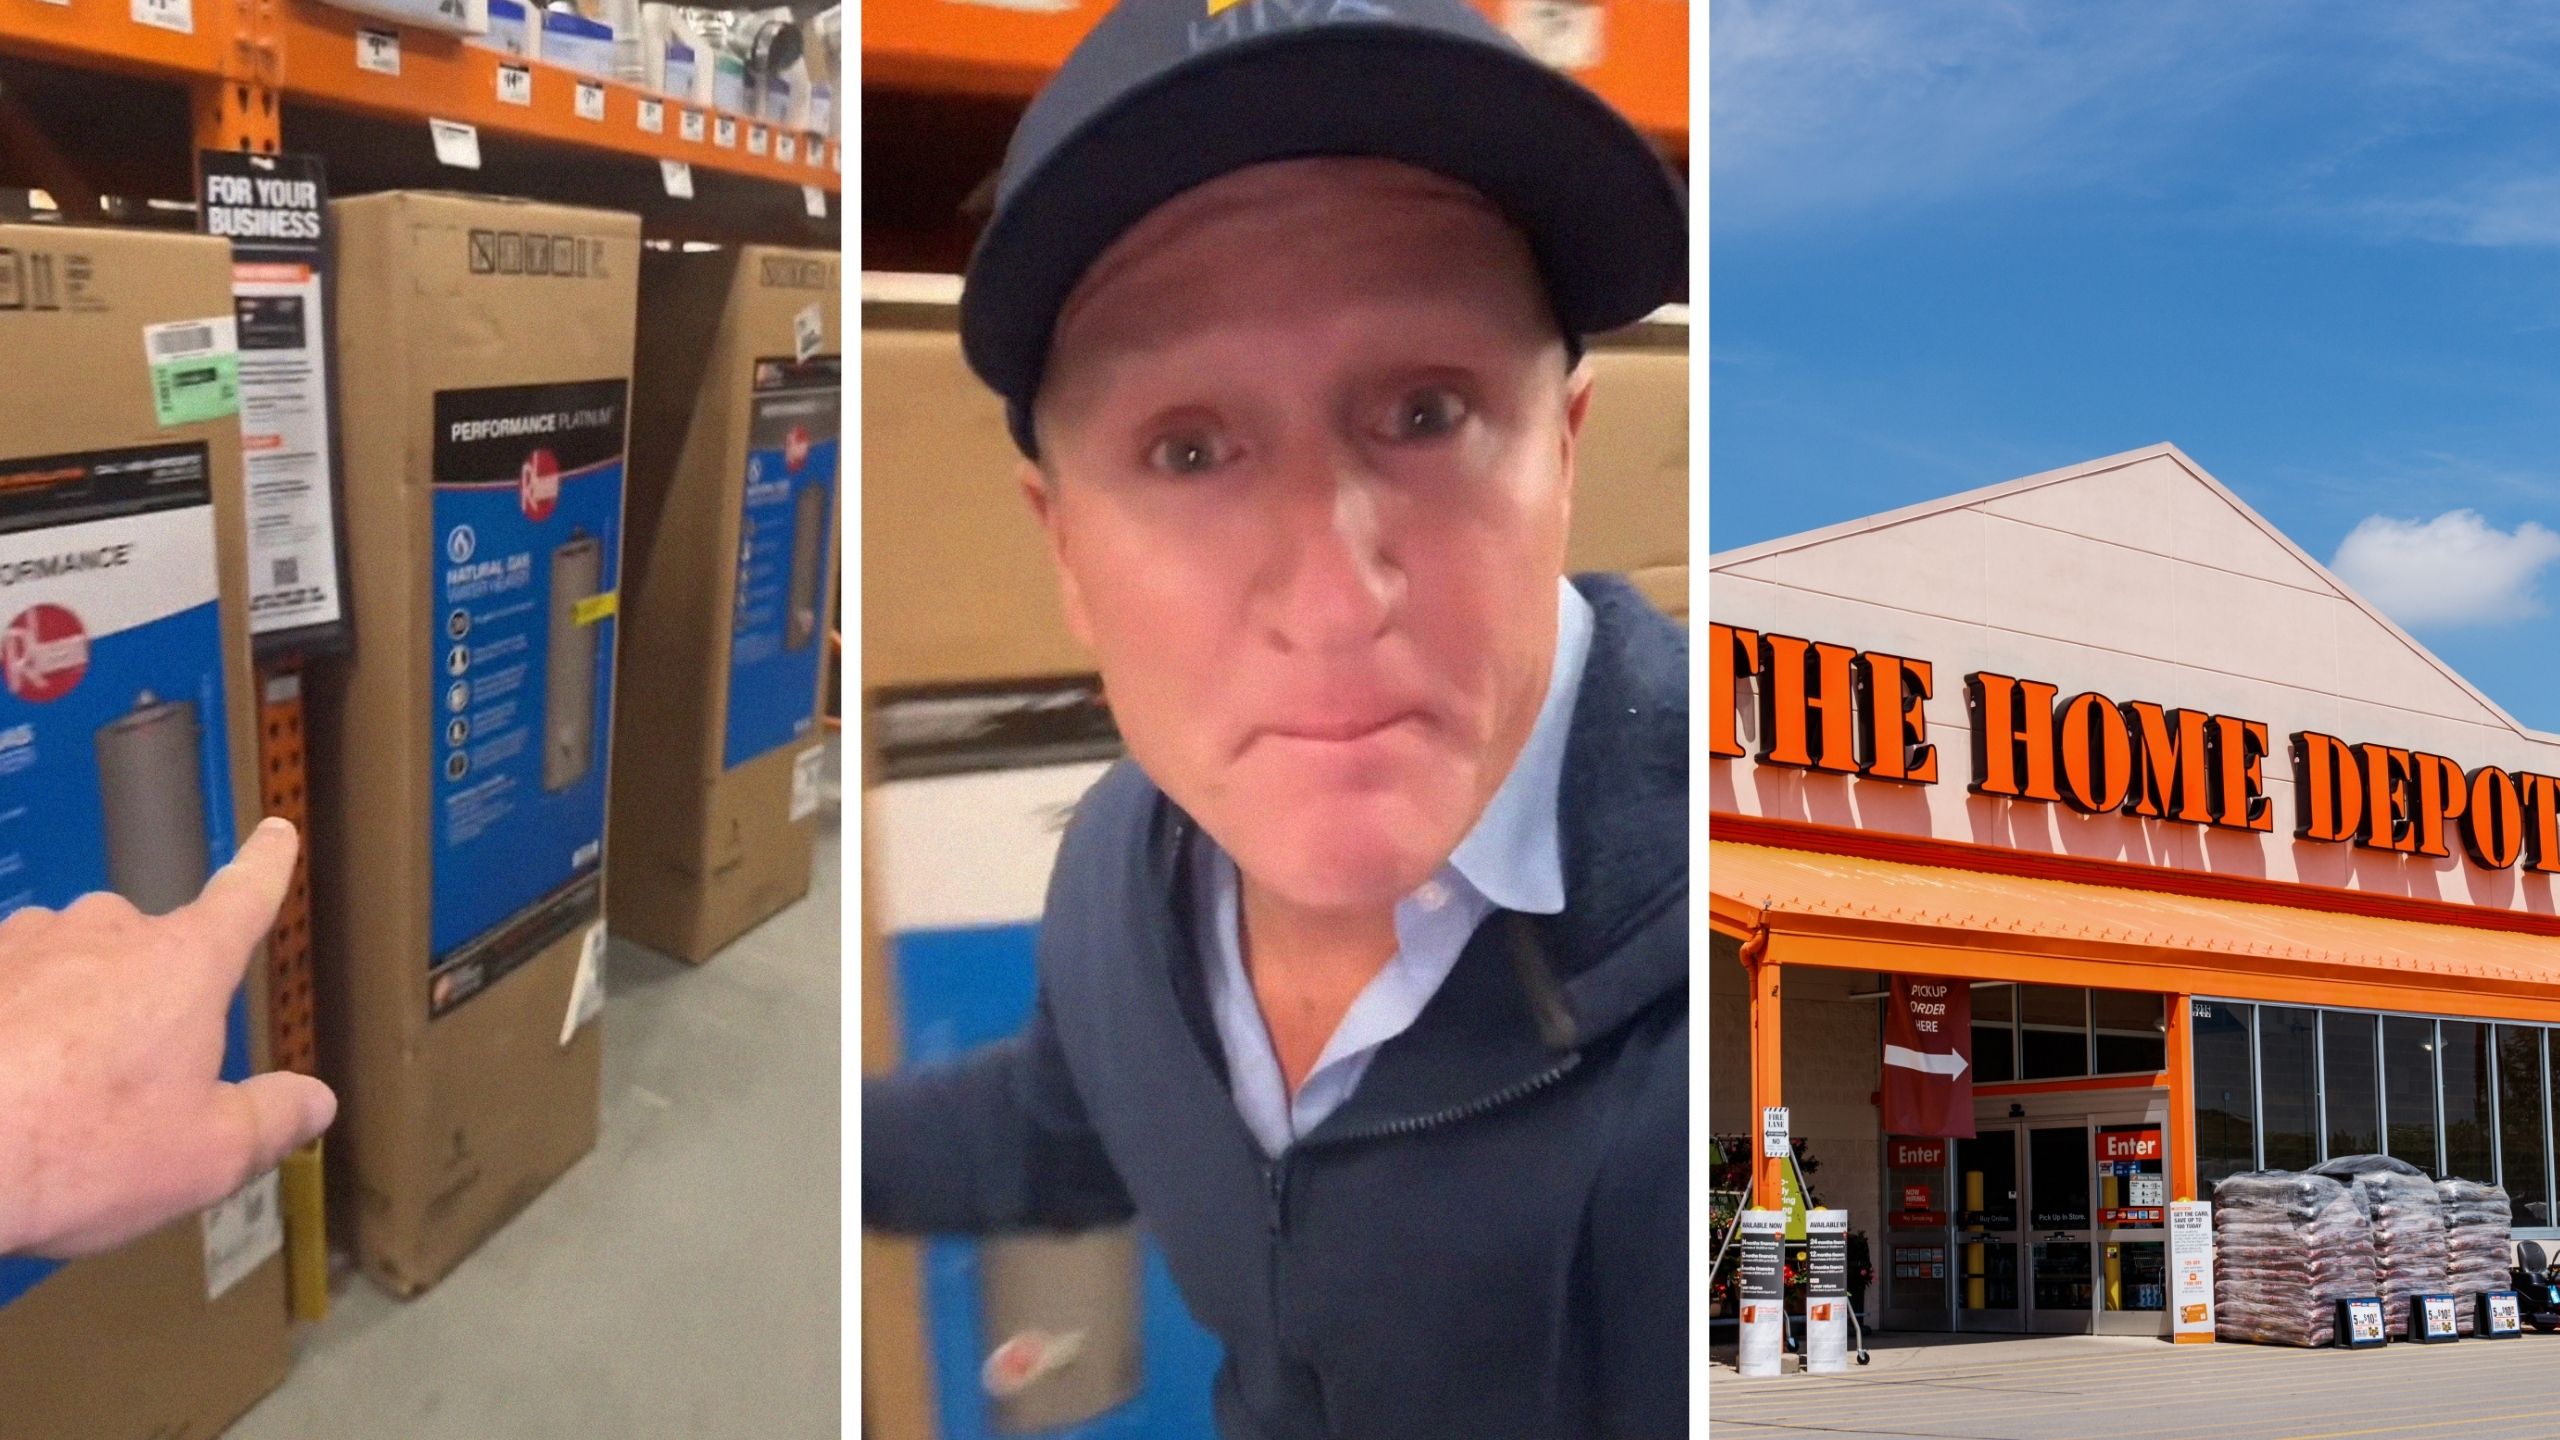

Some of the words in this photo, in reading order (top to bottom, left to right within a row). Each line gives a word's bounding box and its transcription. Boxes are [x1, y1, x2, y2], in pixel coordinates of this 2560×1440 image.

[208, 175, 254, 204] FOR
[256, 178, 316, 209] YOUR
[208, 206, 320, 238] BUSINESS
[451, 413, 556, 443] PERFORMANCE
[1709, 621, 1939, 786] THE
[1963, 670, 2274, 834] HOME
[2288, 730, 2560, 874] DEPOT
[1911, 984, 1948, 998] PICKUP
[1910, 1000, 1946, 1015] ORDER
[1915, 1019, 1939, 1033] HERE
[2107, 1135, 2156, 1156] Enter
[1899, 1145, 1941, 1164] Enter
[1905, 1188, 1920, 1196] NOW
[1809, 1220, 1839, 1229] AVAILABLE
[2039, 1213, 2052, 1221] Pick
[2052, 1214, 2061, 1222] Up
[2428, 1309, 2433, 1321] 5
[2492, 1306, 2498, 1317] 5
[2353, 1314, 2359, 1325] 5
